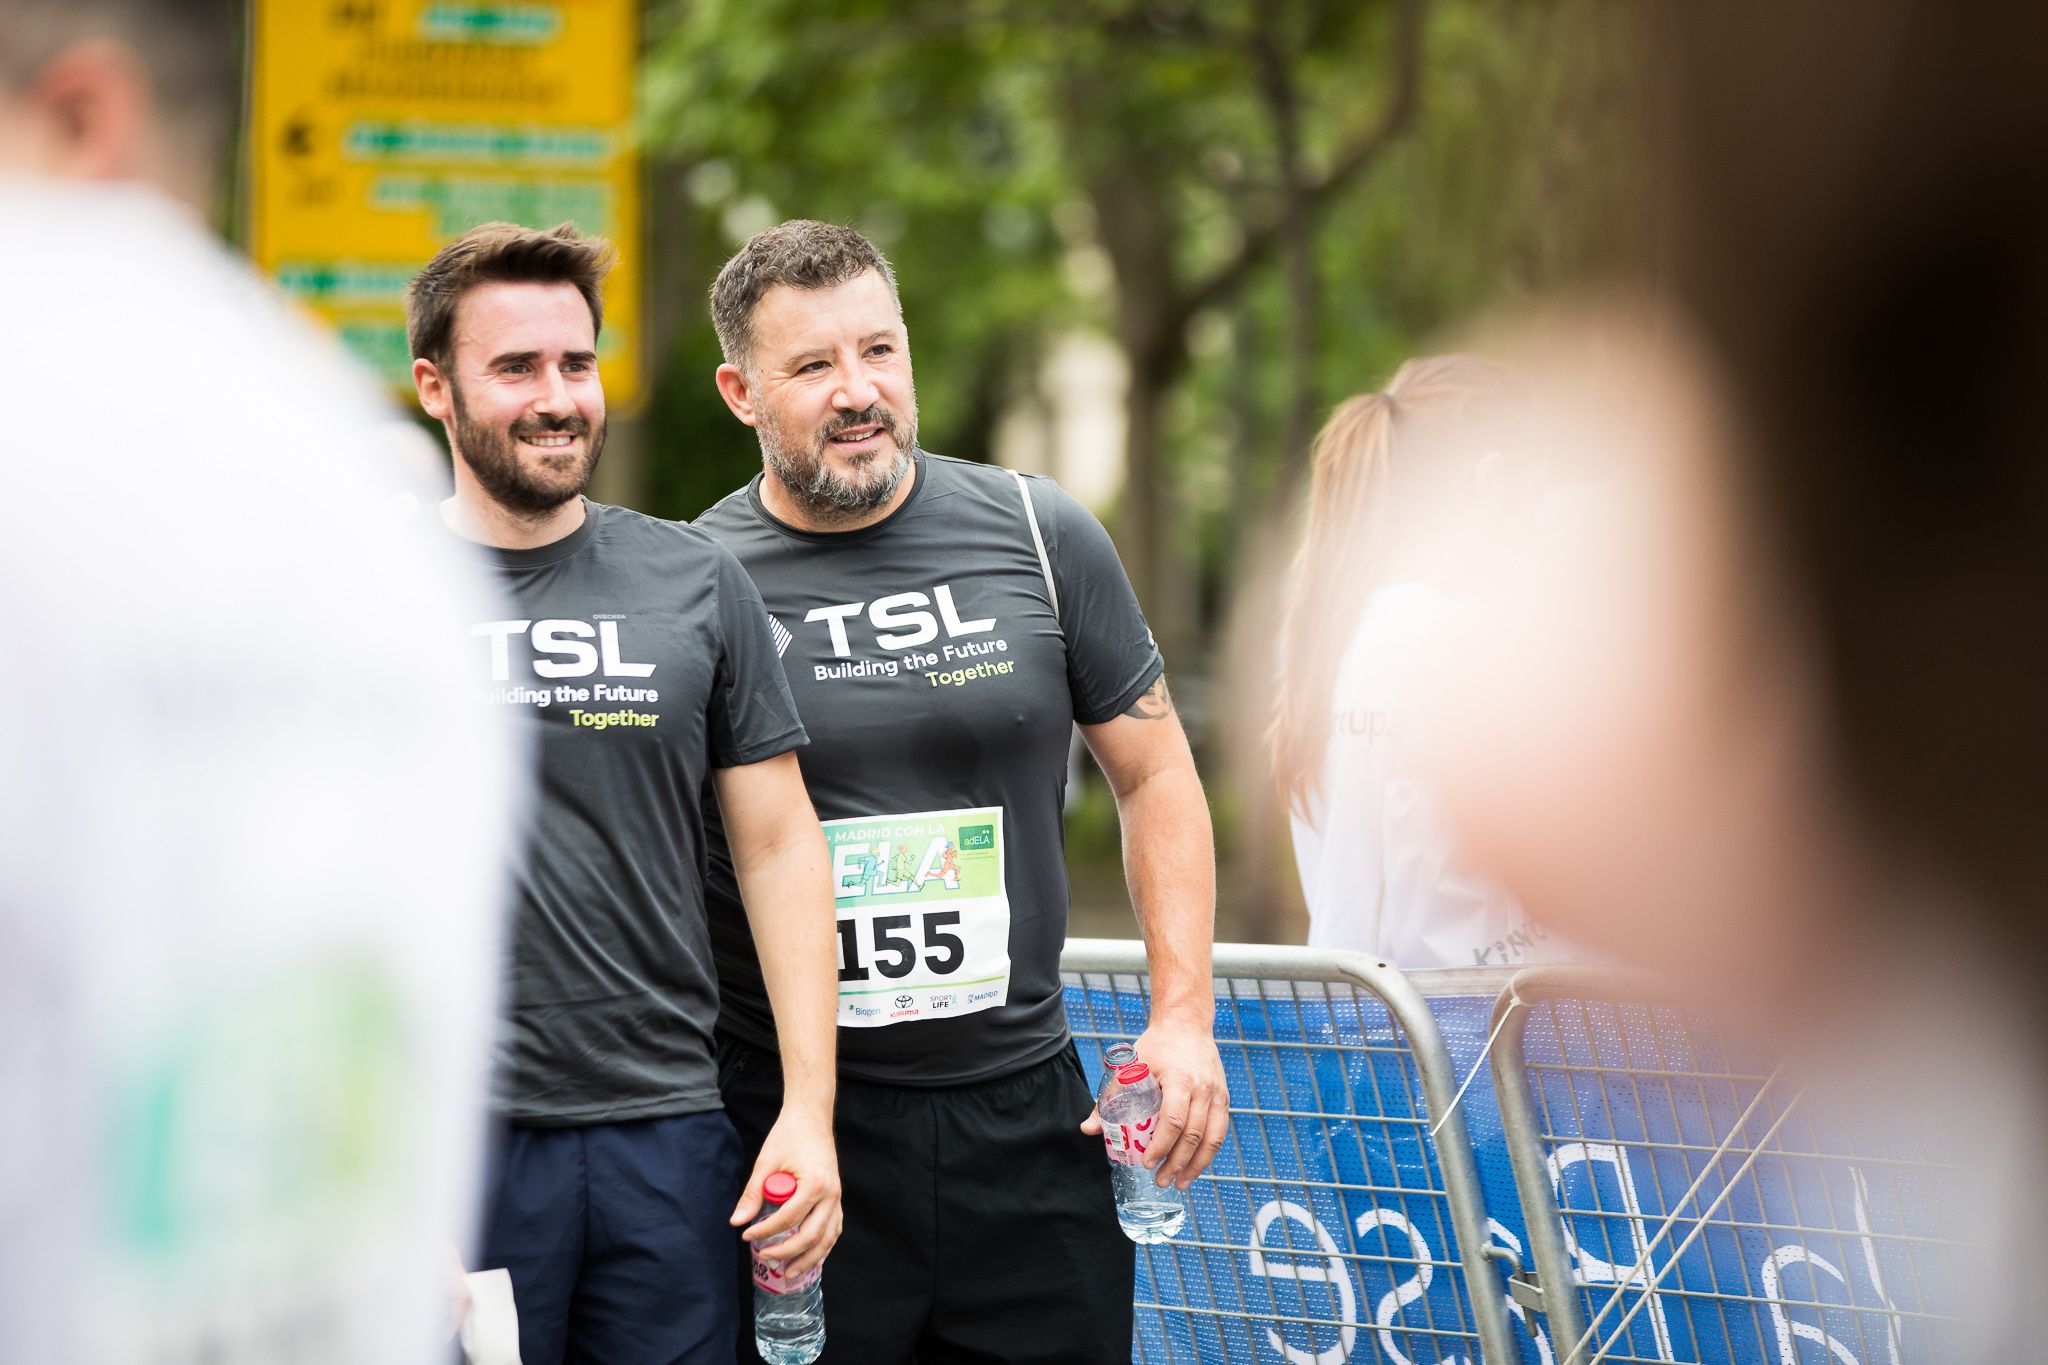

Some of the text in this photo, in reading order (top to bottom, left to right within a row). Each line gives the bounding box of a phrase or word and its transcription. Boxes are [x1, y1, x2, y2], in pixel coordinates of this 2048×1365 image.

[804, 584, 997, 657] TSL
[467, 619, 657, 681] TSL
[814, 639, 1008, 681] Building the Future
[925, 660, 1015, 688] Together
[477, 684, 659, 707] uilding the Future
[569, 708, 659, 730] Together
[835, 828, 891, 843] MADRID
[893, 825, 925, 838] CON
[928, 823, 945, 835] LA
[964, 835, 990, 846] adELA
[833, 837, 960, 899] ELA
[837, 910, 965, 982] 155
[930, 994, 952, 1002] SPORT
[932, 1001, 949, 1009] LIFE
[974, 991, 999, 1001] MADRID
[855, 1006, 881, 1017] Biogen
